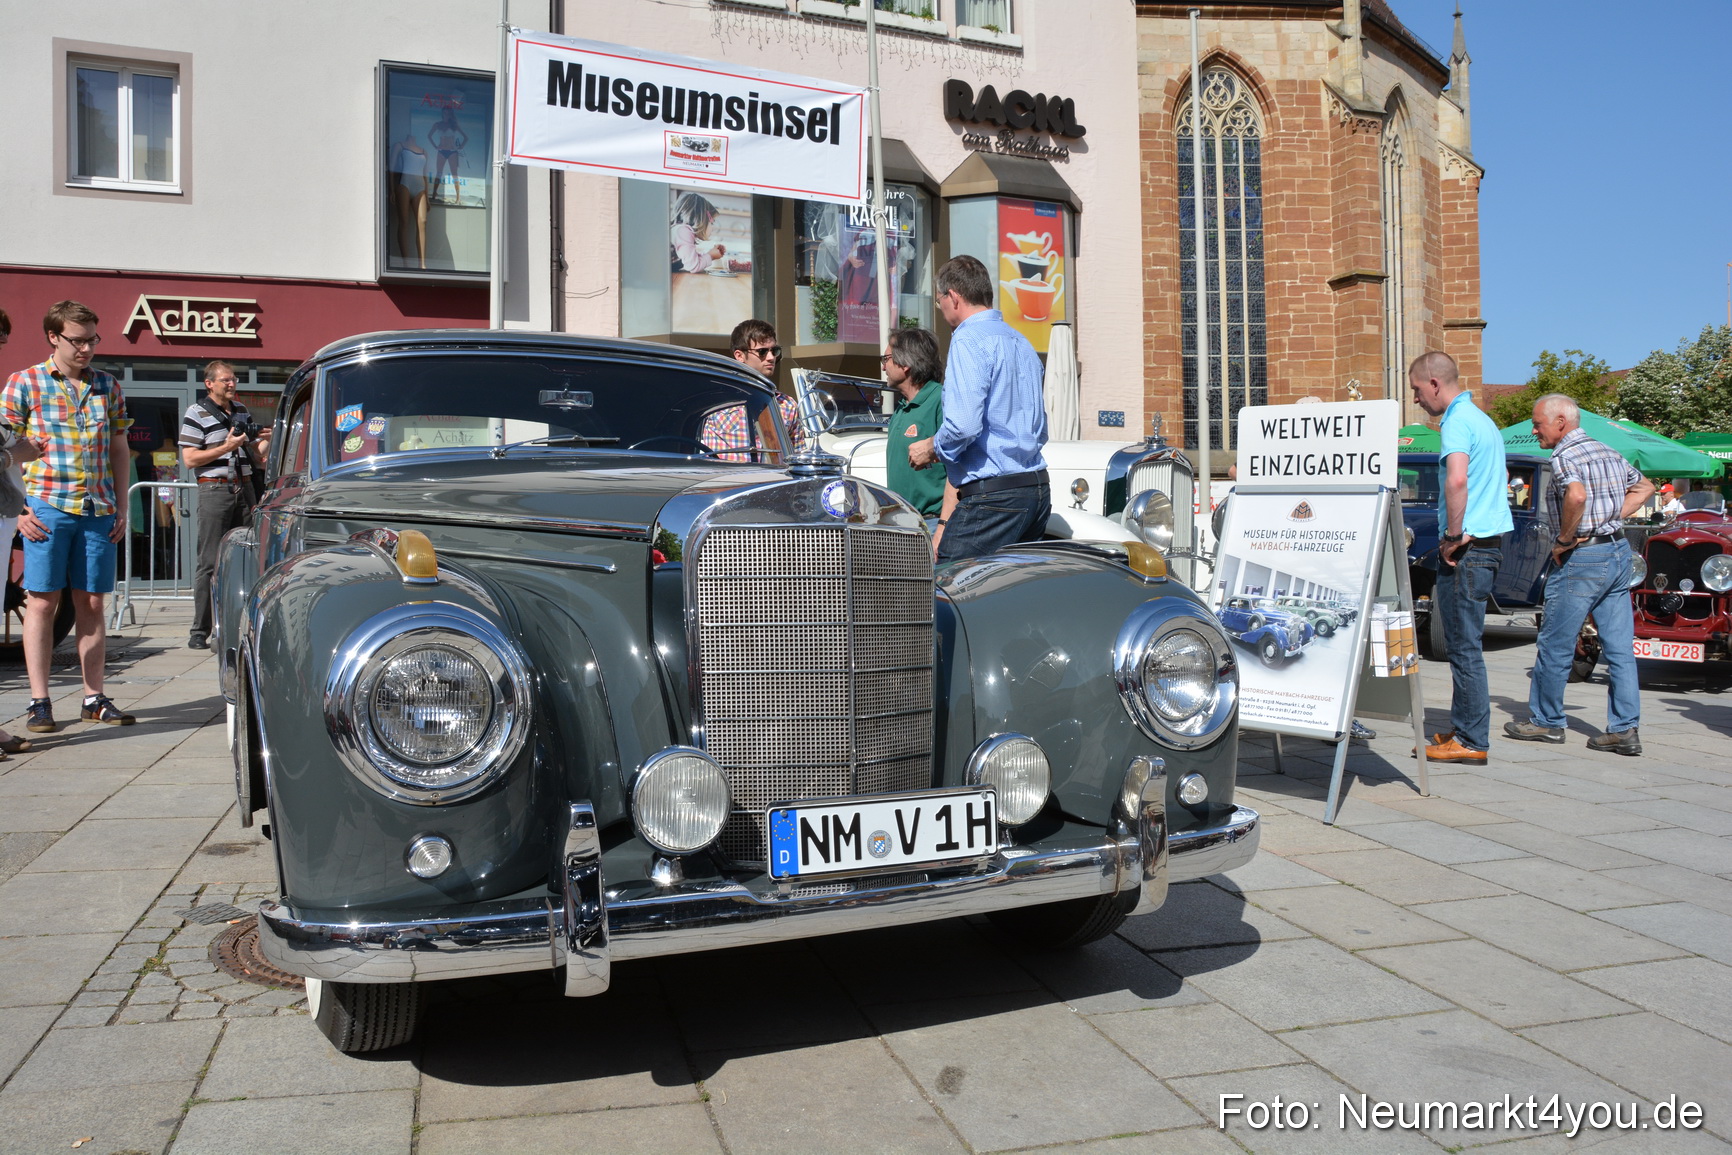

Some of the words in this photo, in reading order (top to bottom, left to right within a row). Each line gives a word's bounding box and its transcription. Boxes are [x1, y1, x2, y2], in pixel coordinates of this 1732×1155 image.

[547, 59, 841, 145] Museumsinsel
[943, 79, 1087, 138] RACKL
[962, 131, 991, 146] am
[995, 129, 1070, 158] Rathaus
[122, 293, 257, 339] Achatz
[1260, 414, 1366, 440] WELTWEIT
[433, 430, 475, 443] Achatz
[1250, 452, 1381, 477] EINZIGARTIG
[1243, 529, 1278, 539] MUSEUM
[1280, 527, 1297, 540] FÜR
[1299, 530, 1358, 541] HISTORISCHE
[1250, 541, 1345, 553] MAYBACH-FAHRZEUGE
[1661, 643, 1700, 660] 0728
[1242, 687, 1274, 696] HISTORISCHE
[1275, 699, 1297, 707] Neumarkt
[1266, 714, 1329, 726] www.automuseum-maybach.de
[799, 812, 863, 866] NM
[894, 806, 922, 856] V
[934, 800, 993, 852] 1H
[780, 850, 790, 864] D
